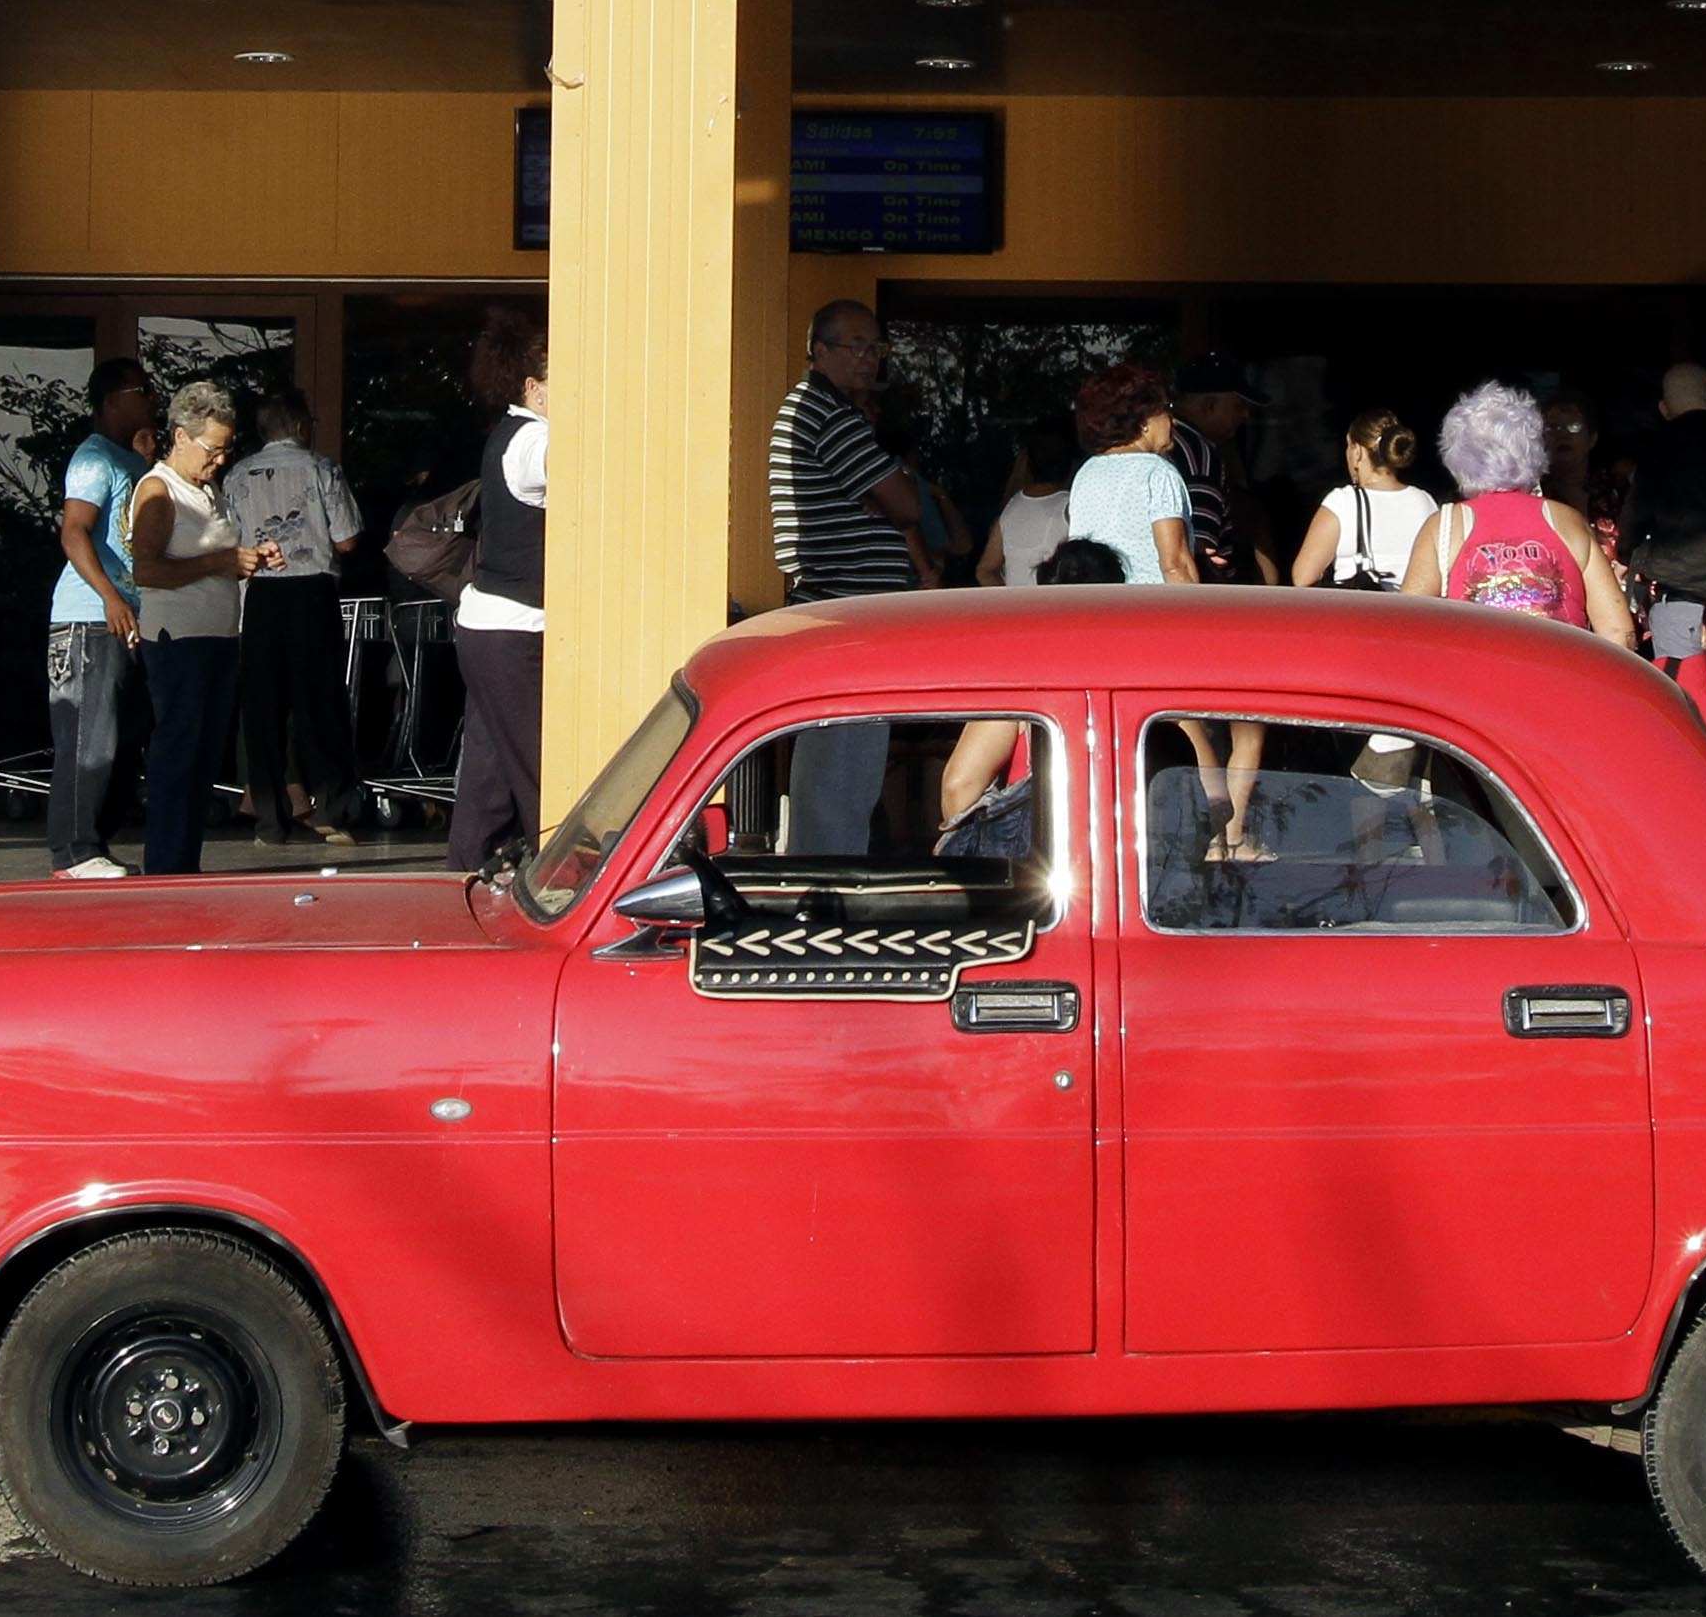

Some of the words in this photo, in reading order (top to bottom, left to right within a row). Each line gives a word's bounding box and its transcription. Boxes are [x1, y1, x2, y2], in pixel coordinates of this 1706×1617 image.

[805, 123, 873, 140] Salidas
[790, 159, 827, 171] AMI
[884, 160, 909, 172] On
[916, 160, 962, 172] Time
[790, 195, 826, 207] AMI
[883, 195, 909, 207] On
[916, 195, 962, 208] Time
[790, 212, 825, 224] AMI
[883, 212, 908, 224] On
[916, 212, 962, 224] Time
[798, 228, 874, 241] MEXICO
[883, 229, 908, 241] On
[916, 230, 962, 242] Time
